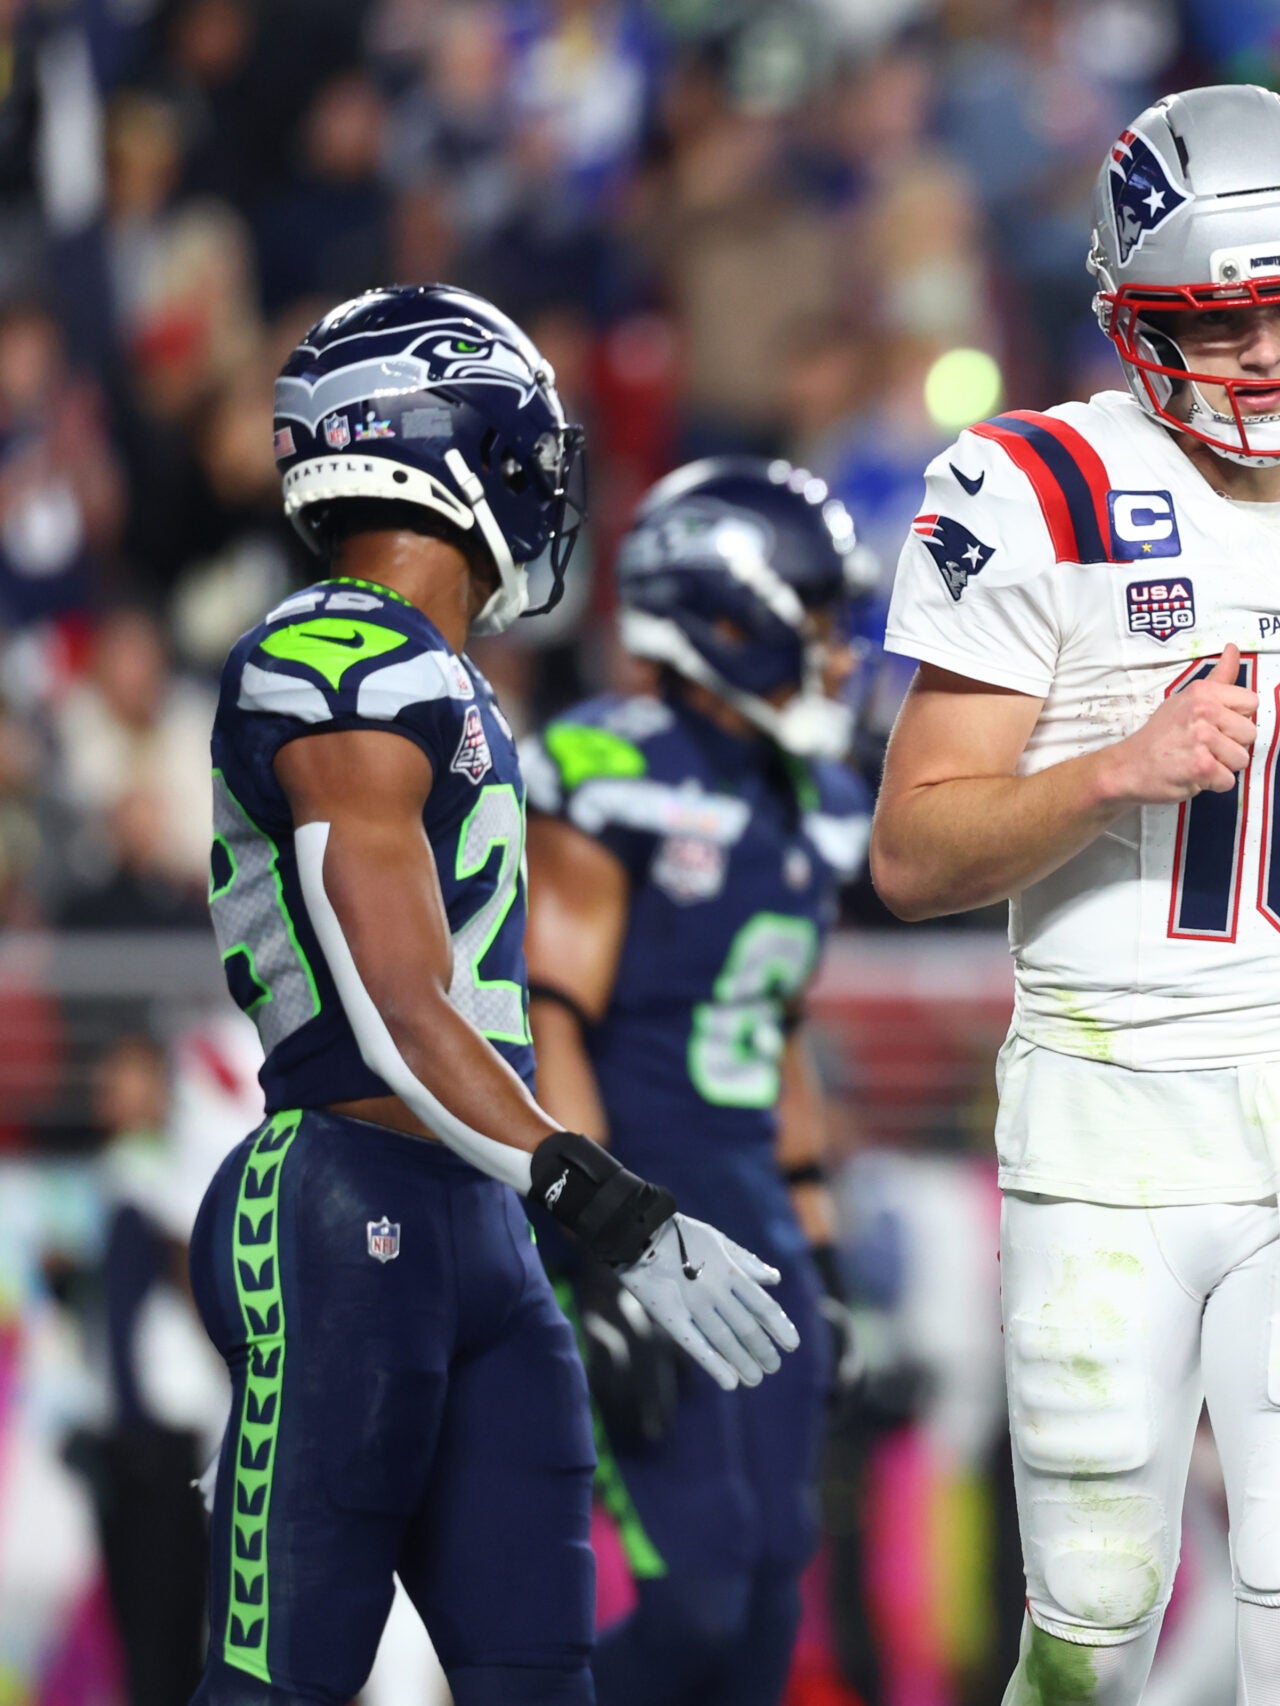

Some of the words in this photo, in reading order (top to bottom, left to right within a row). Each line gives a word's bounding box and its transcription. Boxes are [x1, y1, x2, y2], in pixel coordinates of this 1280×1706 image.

[1113, 494, 1173, 542] C
[1130, 583, 1189, 602] USA
[1130, 609, 1194, 631] 250
[450, 783, 532, 1045] 2
[373, 1236, 396, 1254] NFL
